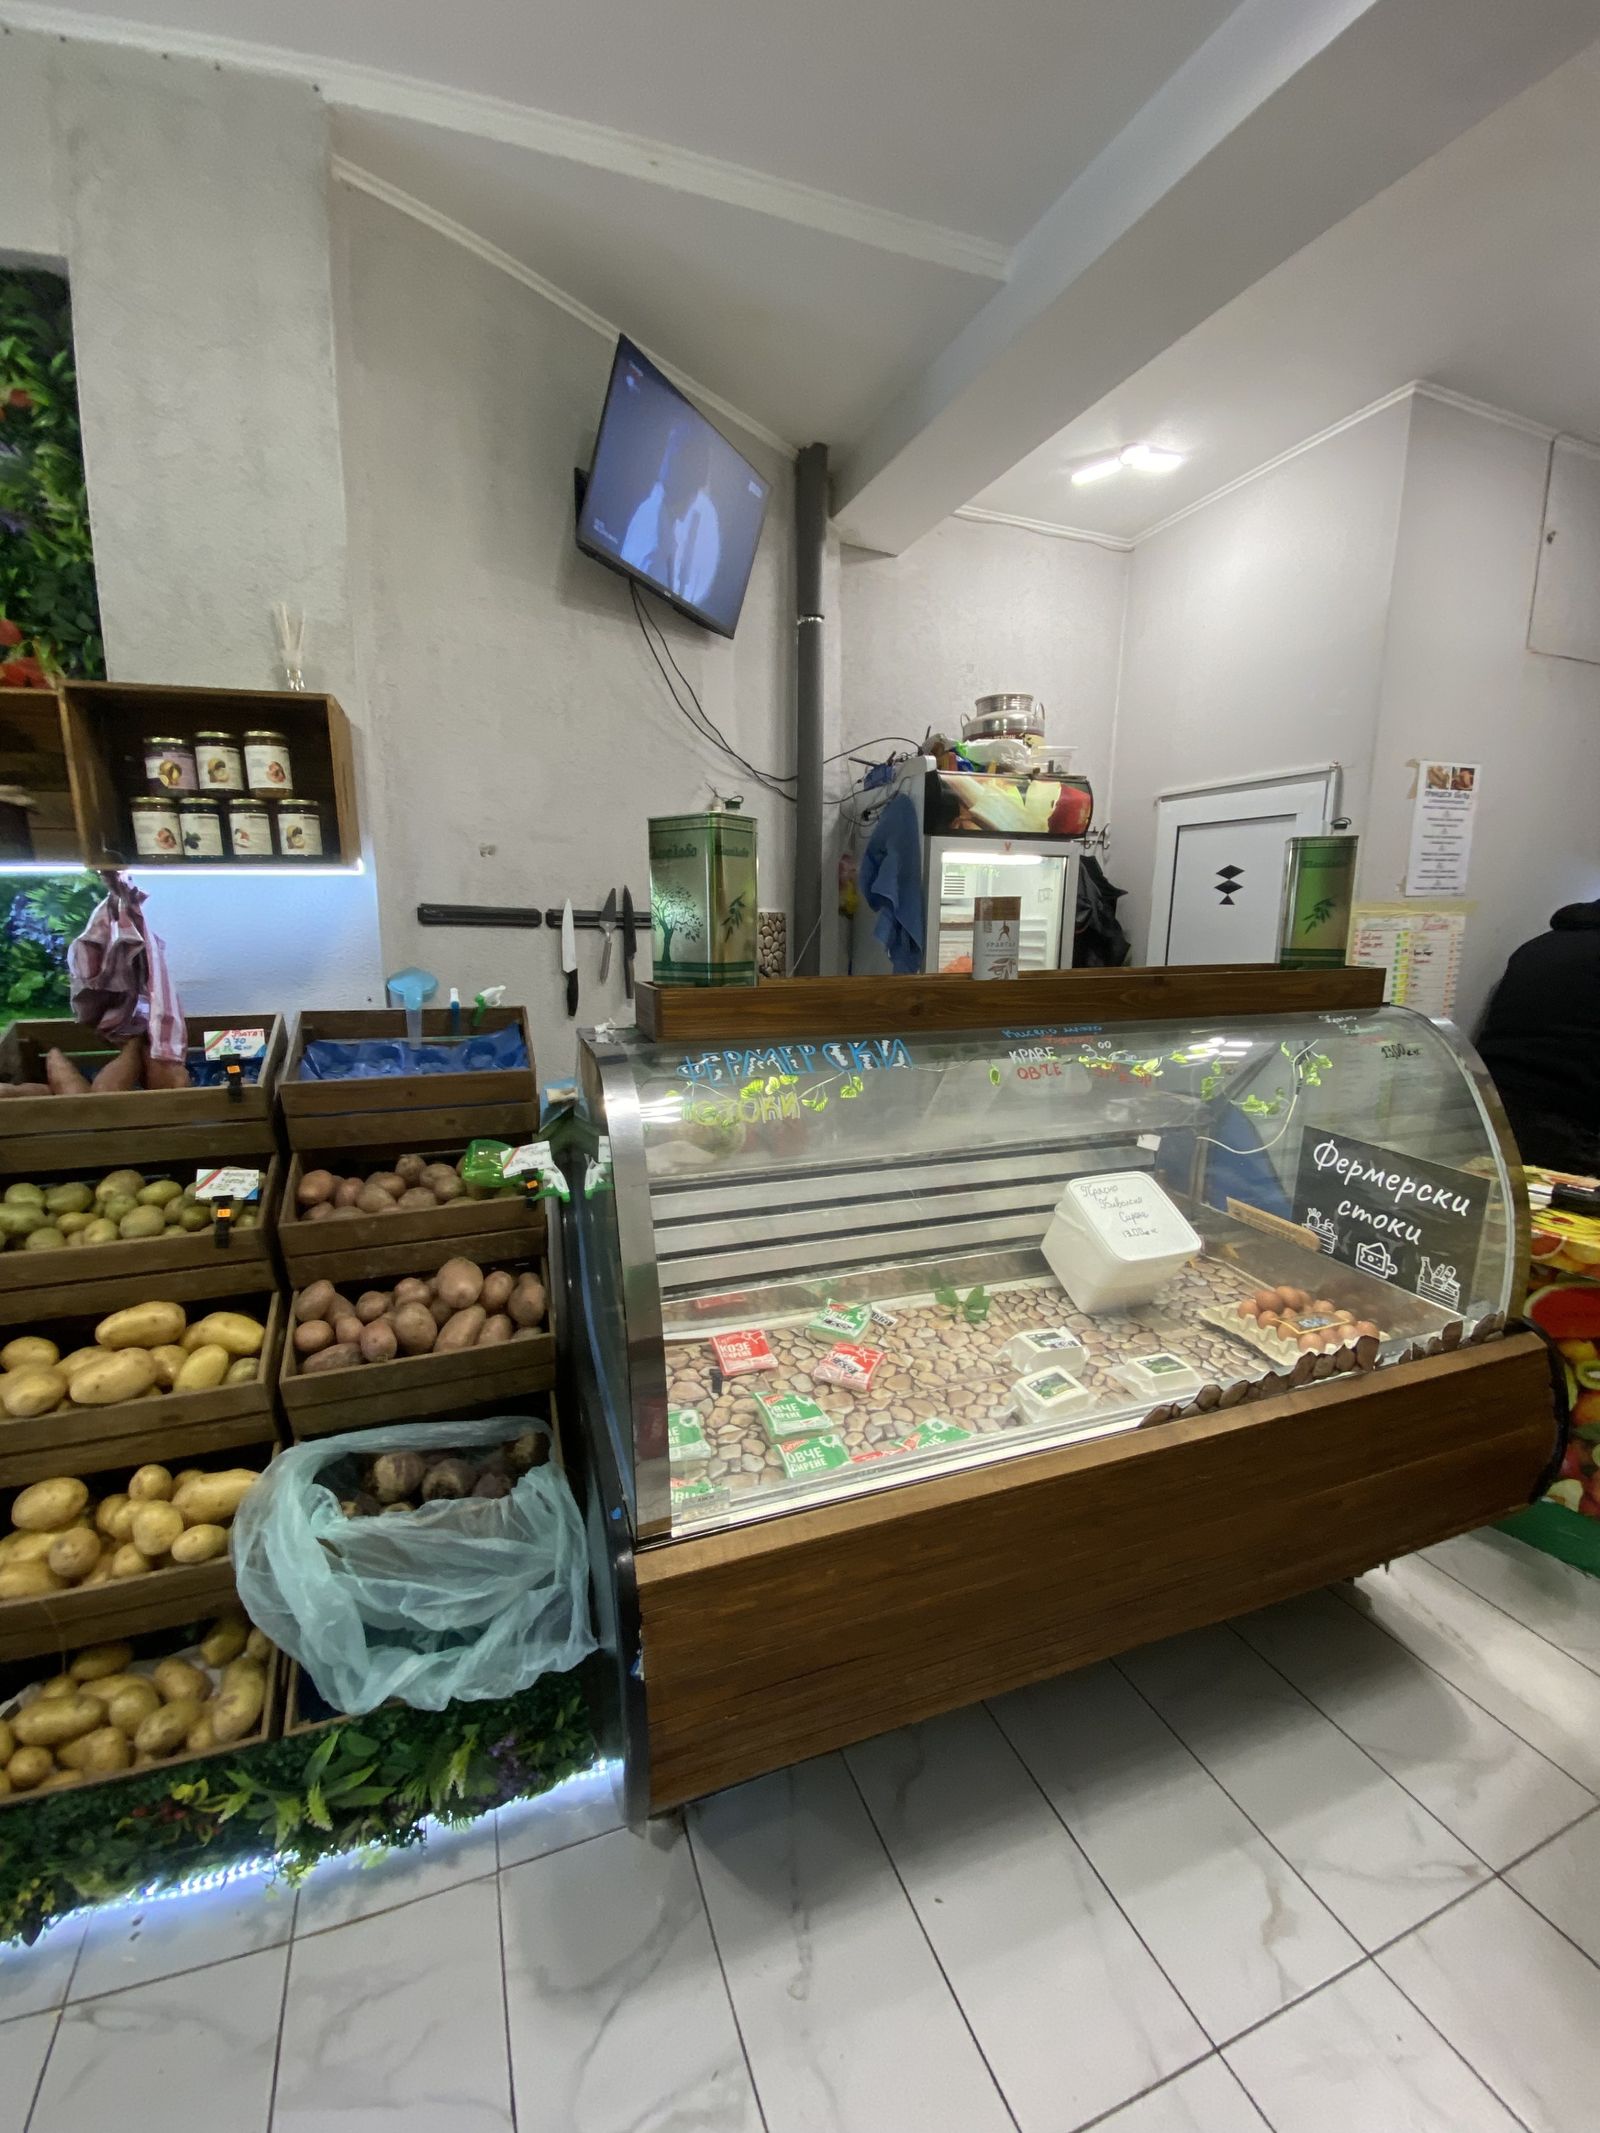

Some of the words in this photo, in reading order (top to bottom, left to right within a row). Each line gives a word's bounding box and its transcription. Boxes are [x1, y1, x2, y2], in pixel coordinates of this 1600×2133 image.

[676, 1038, 912, 1088] ФЕРМЕРСКИ
[1313, 1139, 1471, 1216] Фермерски
[1337, 1199, 1422, 1245] стоки
[720, 1341, 751, 1354] КОЗЕ
[786, 1447, 824, 1465] ОВЧЕ
